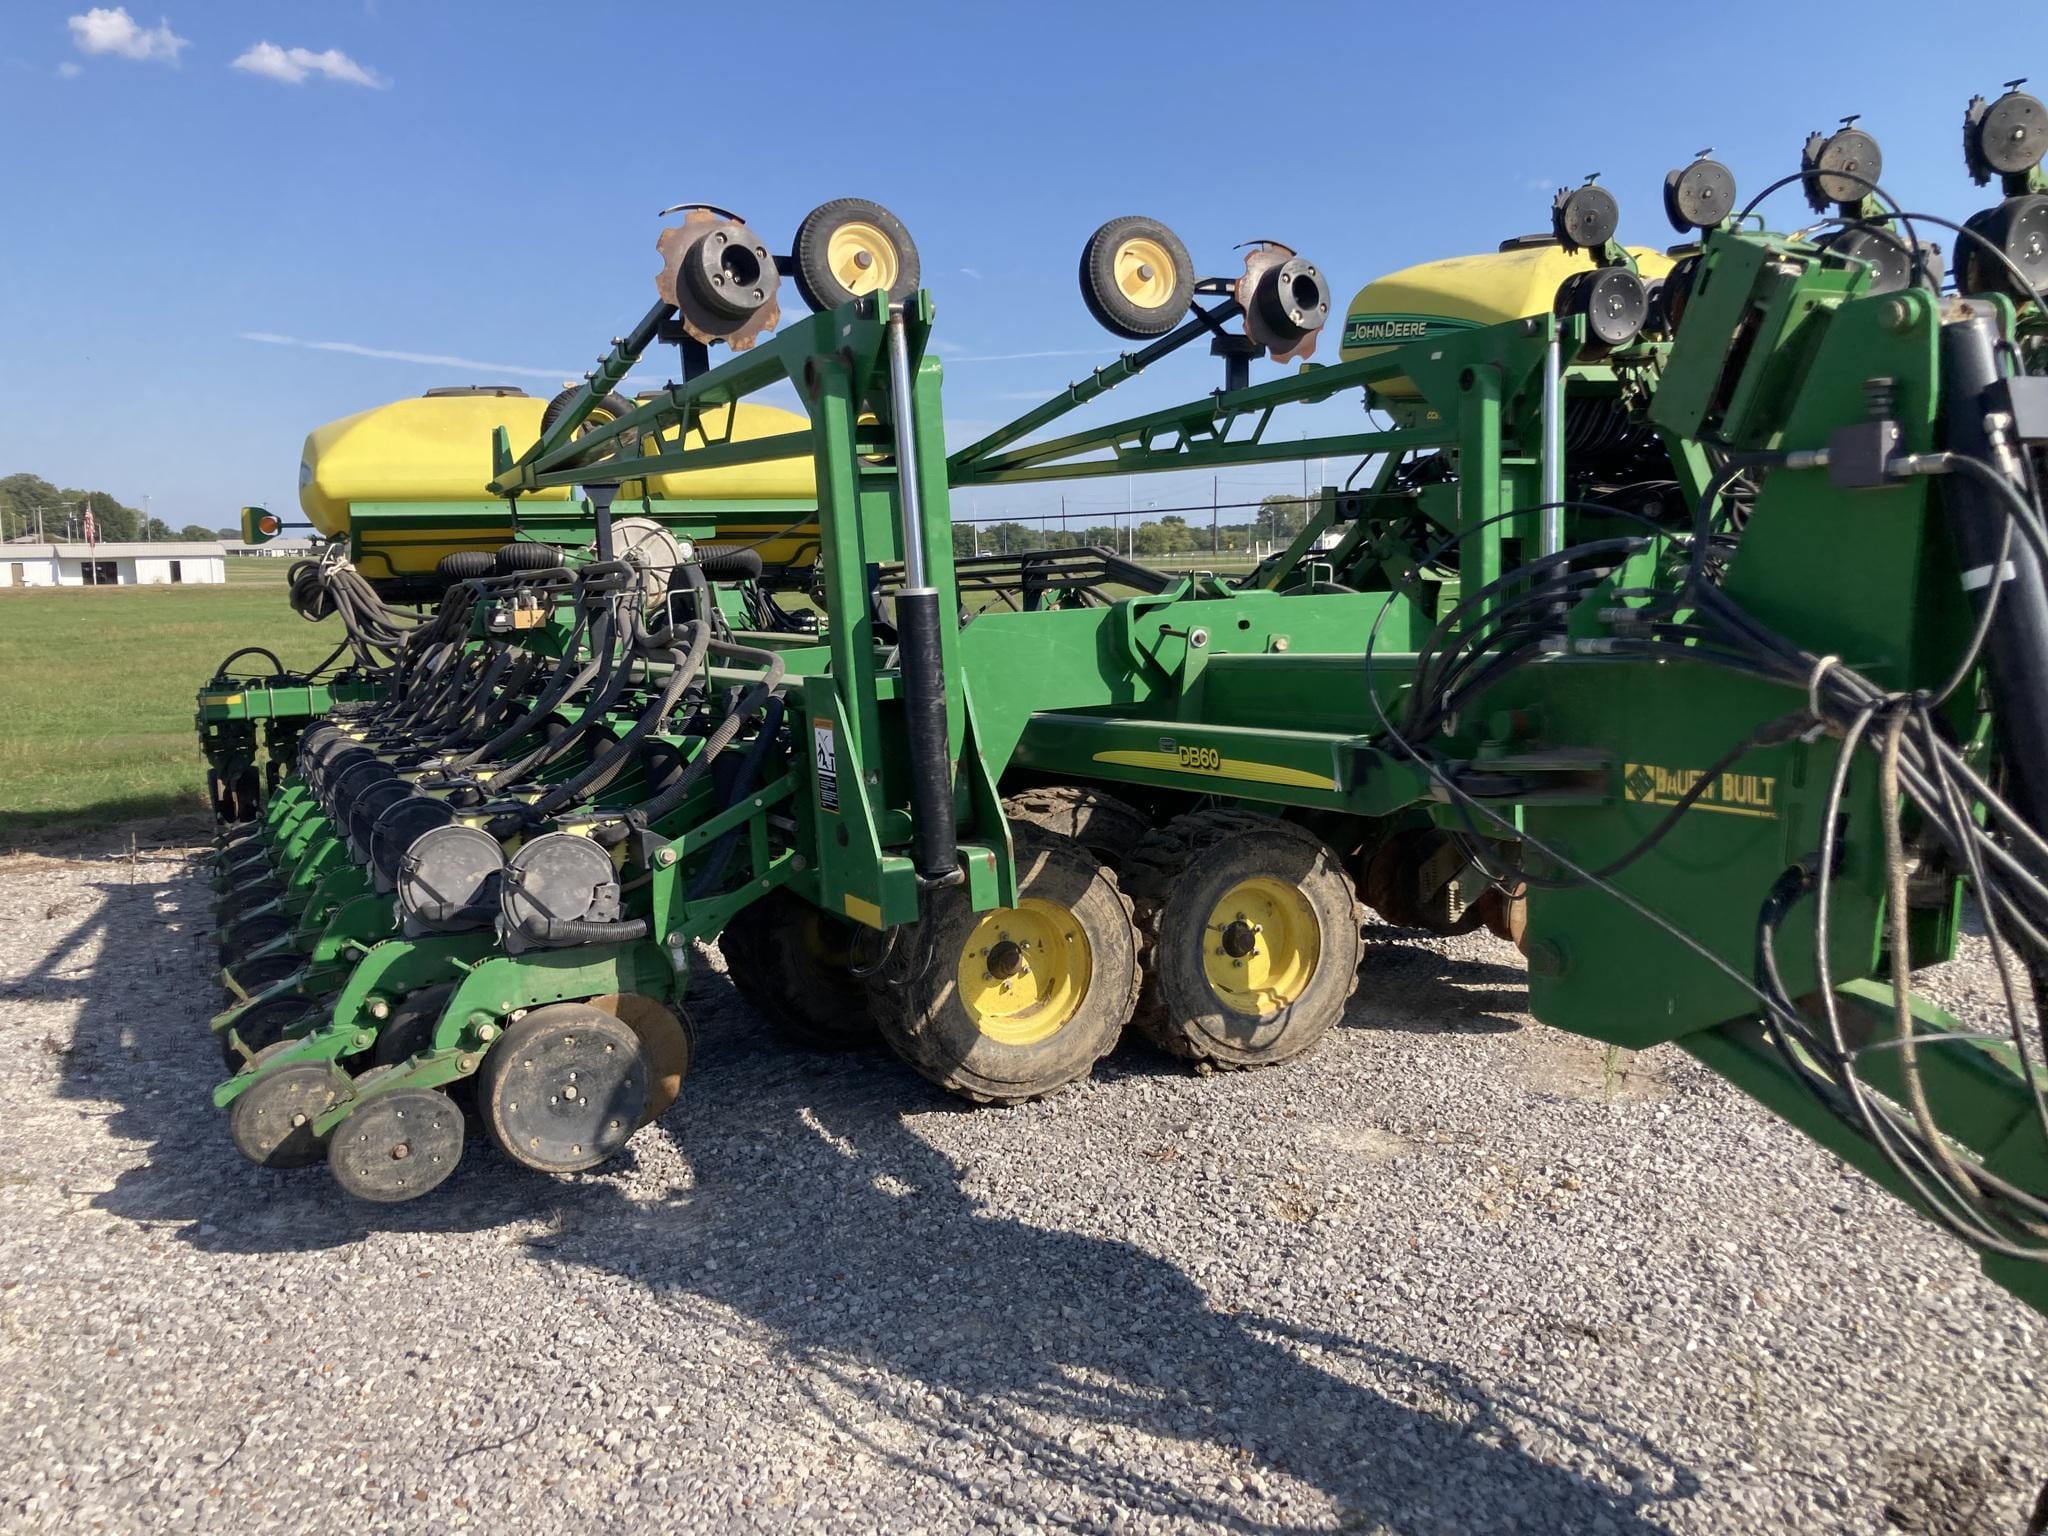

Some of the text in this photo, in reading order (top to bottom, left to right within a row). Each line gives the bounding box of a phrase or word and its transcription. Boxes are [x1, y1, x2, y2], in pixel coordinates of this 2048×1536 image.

[1351, 321, 1427, 340] JOHN DEERE
[1178, 746, 1219, 769] DB60
[1722, 773, 1776, 806] BUILT
